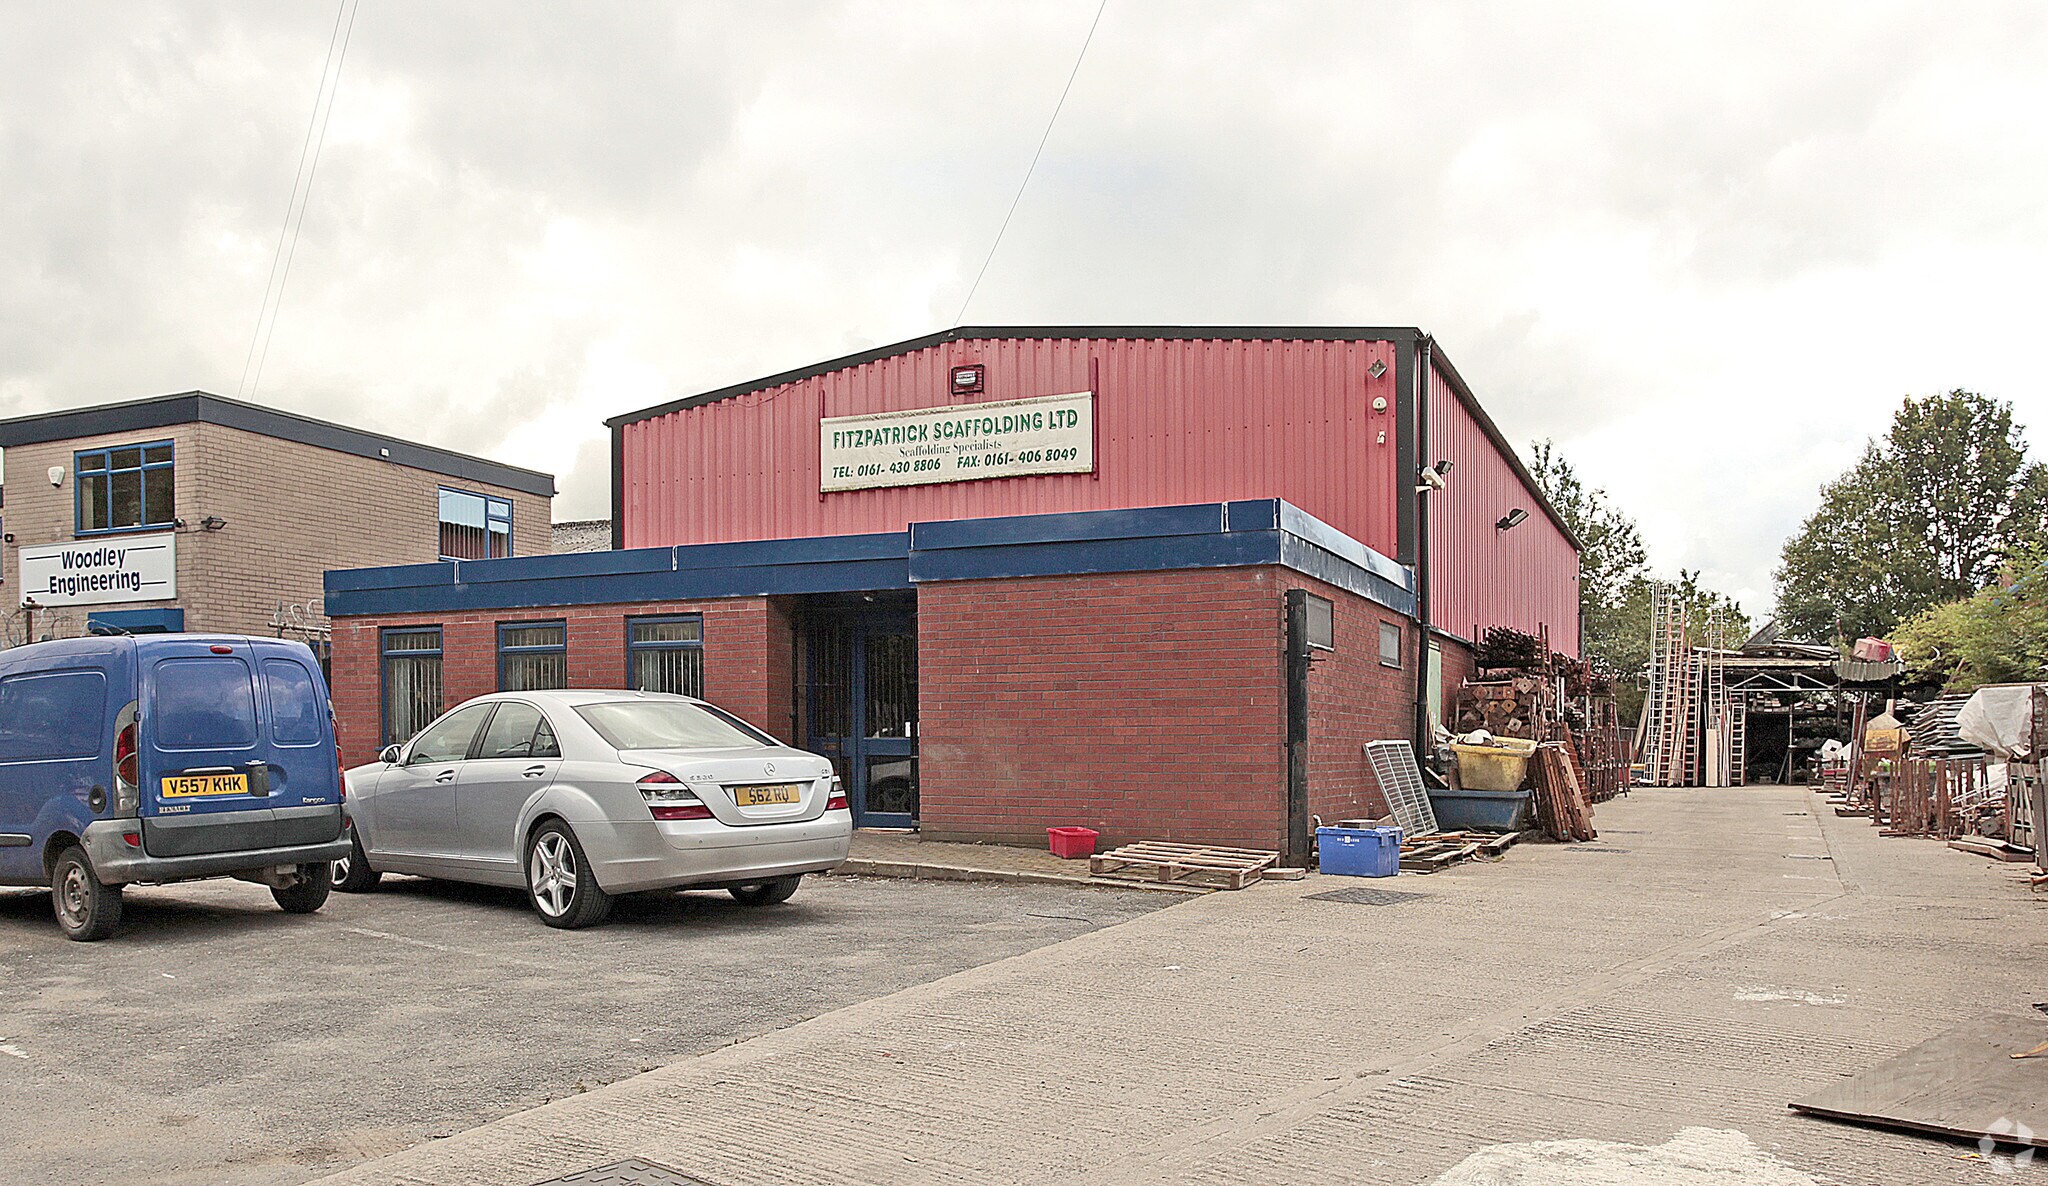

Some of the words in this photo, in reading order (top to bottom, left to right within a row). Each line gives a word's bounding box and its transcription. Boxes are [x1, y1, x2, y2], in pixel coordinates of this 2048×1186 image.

[833, 423, 928, 449] FITZPATRICK
[933, 412, 1043, 440] SCAFFOLDING
[1049, 408, 1079, 430] LTD
[899, 444, 951, 459] Scaffolding
[952, 438, 1002, 453] Specialists
[956, 455, 981, 469] FAX:
[984, 451, 1014, 467] 0161-
[1018, 450, 1042, 465] 406
[1045, 447, 1078, 462] 8049
[832, 466, 854, 479] TEL:
[857, 464, 886, 477] 0161-
[889, 461, 910, 473] 430
[913, 458, 941, 472] 8806
[62, 548, 126, 569] Woodley
[49, 570, 140, 596] Engineering
[169, 779, 208, 794] V557
[213, 777, 242, 792] KHK
[159, 805, 190, 813] RENAULT
